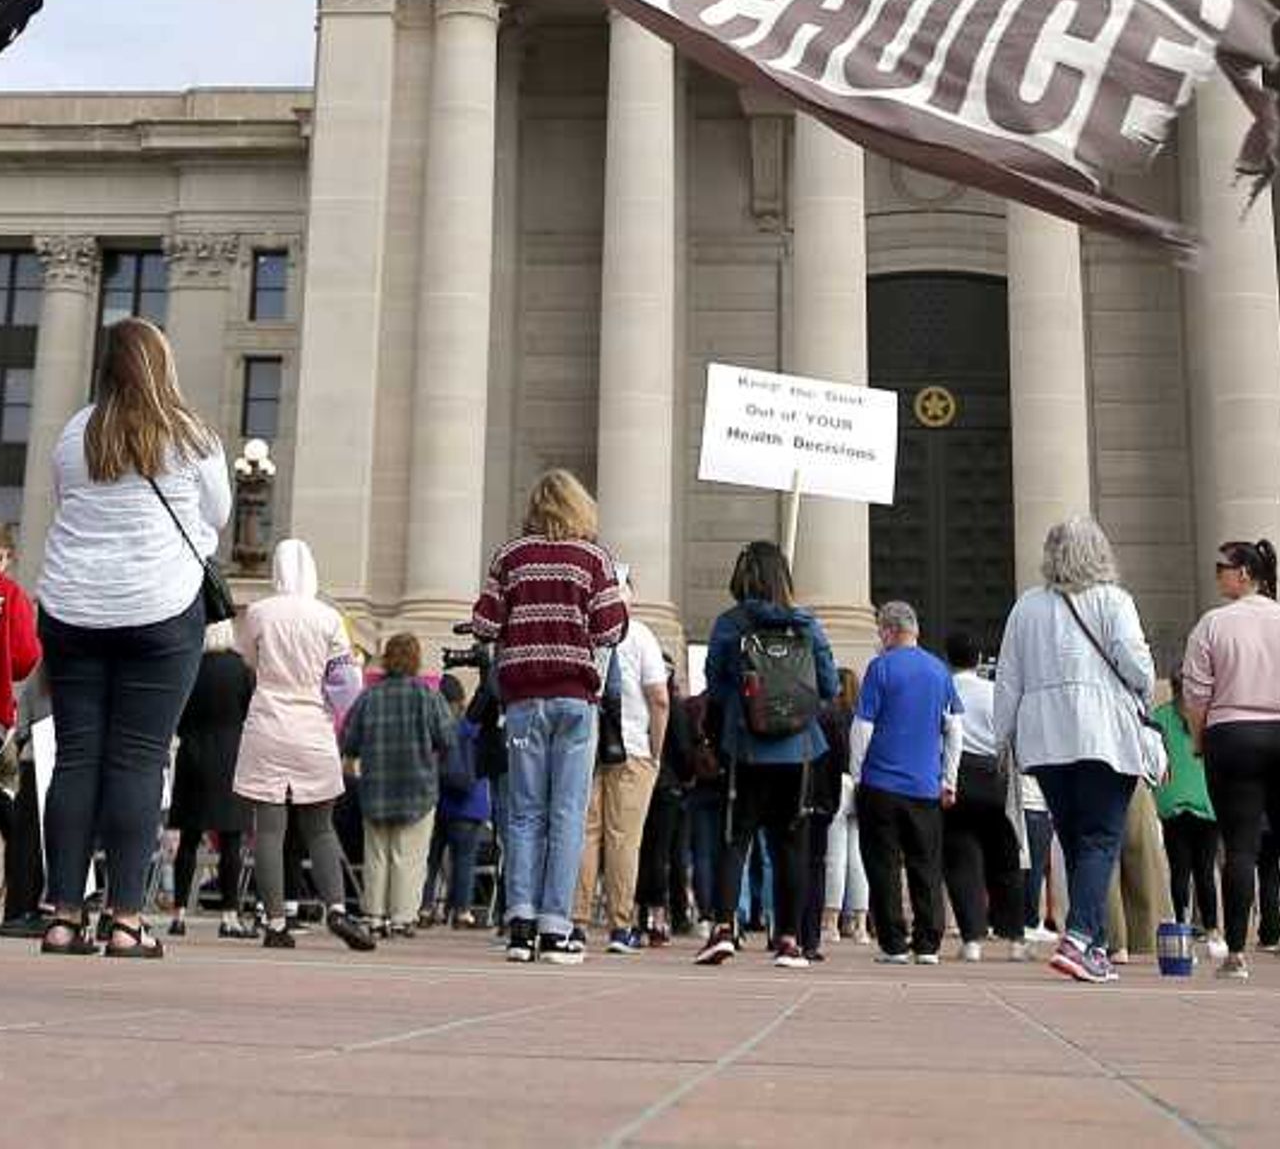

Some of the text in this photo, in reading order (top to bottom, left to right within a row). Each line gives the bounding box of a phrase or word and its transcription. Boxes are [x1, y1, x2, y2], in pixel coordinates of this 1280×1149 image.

[745, 404, 853, 431] Out of YOUR
[726, 426, 877, 461] Health Decisions
